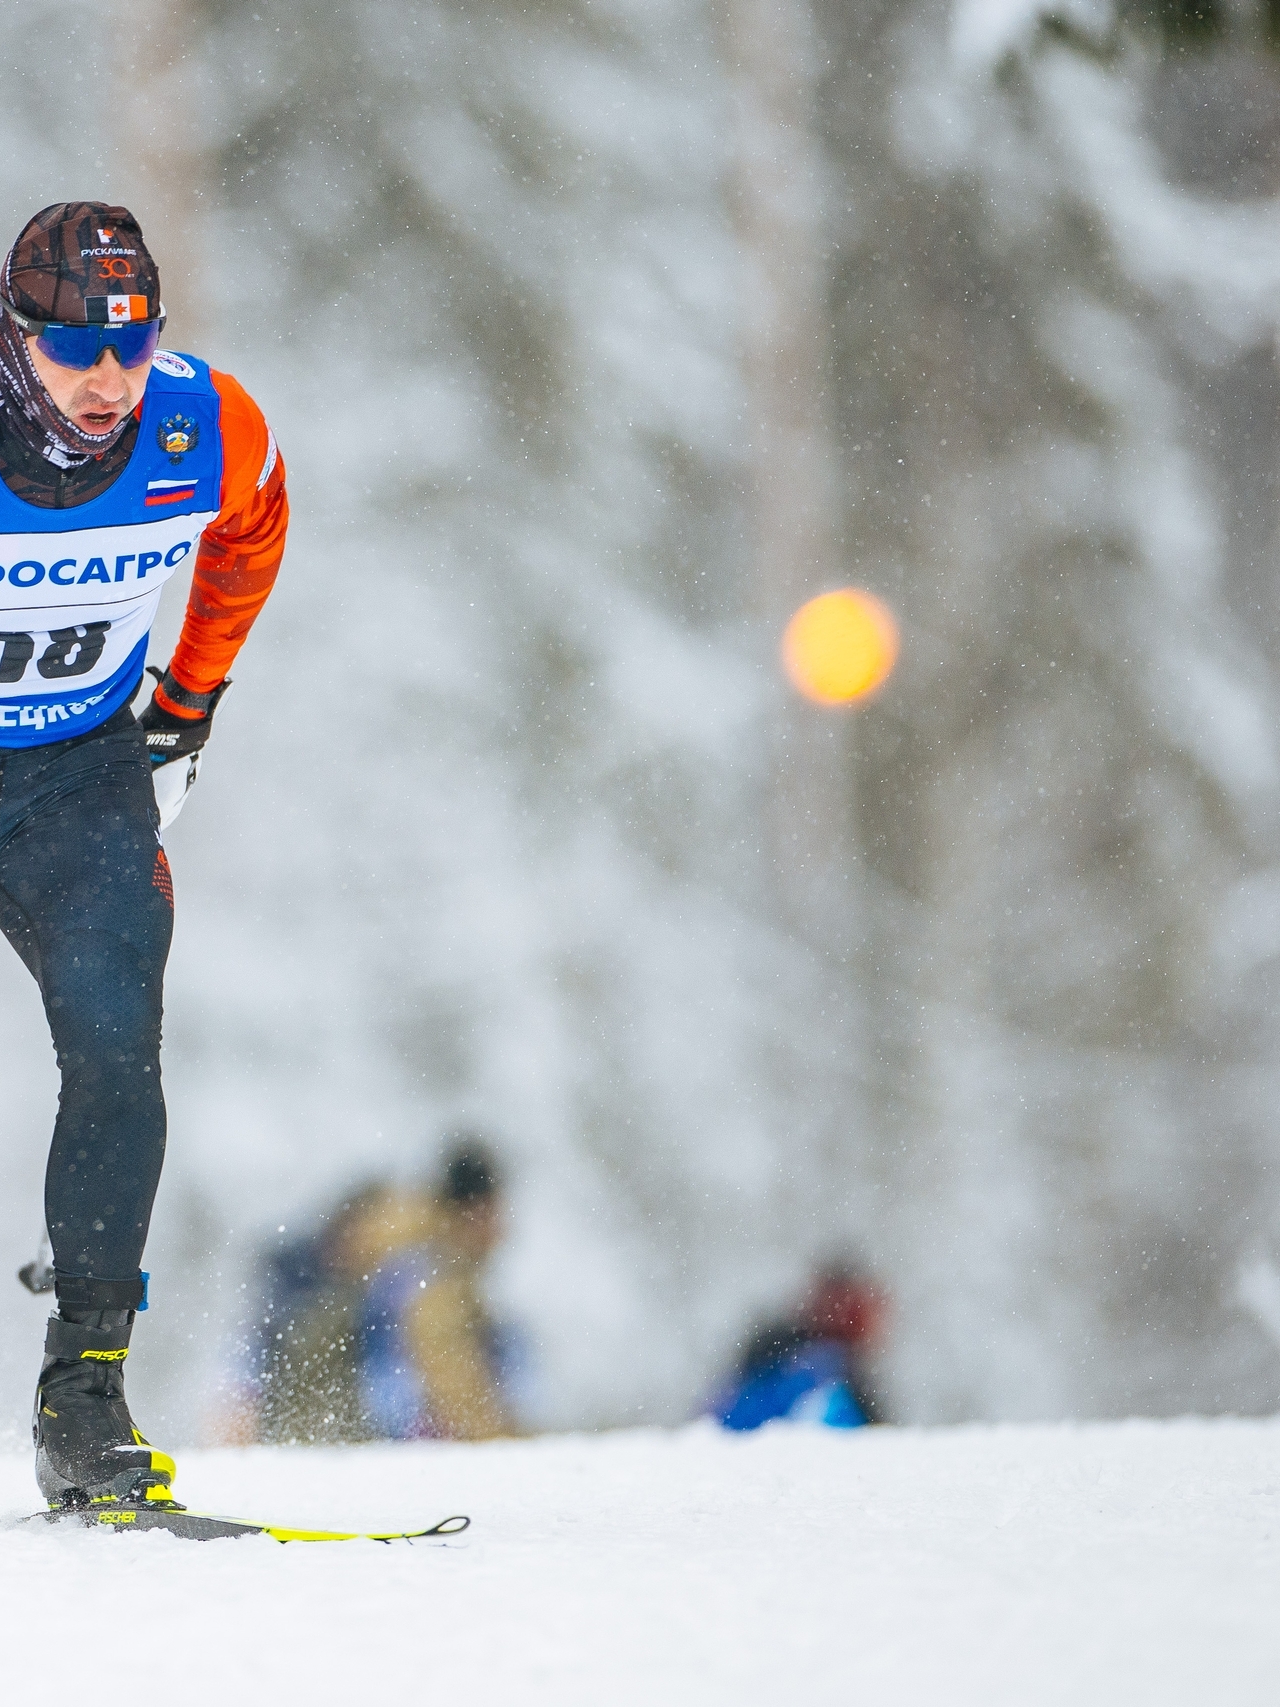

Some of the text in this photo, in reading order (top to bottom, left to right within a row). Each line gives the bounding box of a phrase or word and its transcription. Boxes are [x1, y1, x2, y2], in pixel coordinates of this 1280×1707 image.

[96, 257, 132, 279] 30
[146, 733, 180, 746] SWI
[98, 1511, 137, 1524] FISCHER
